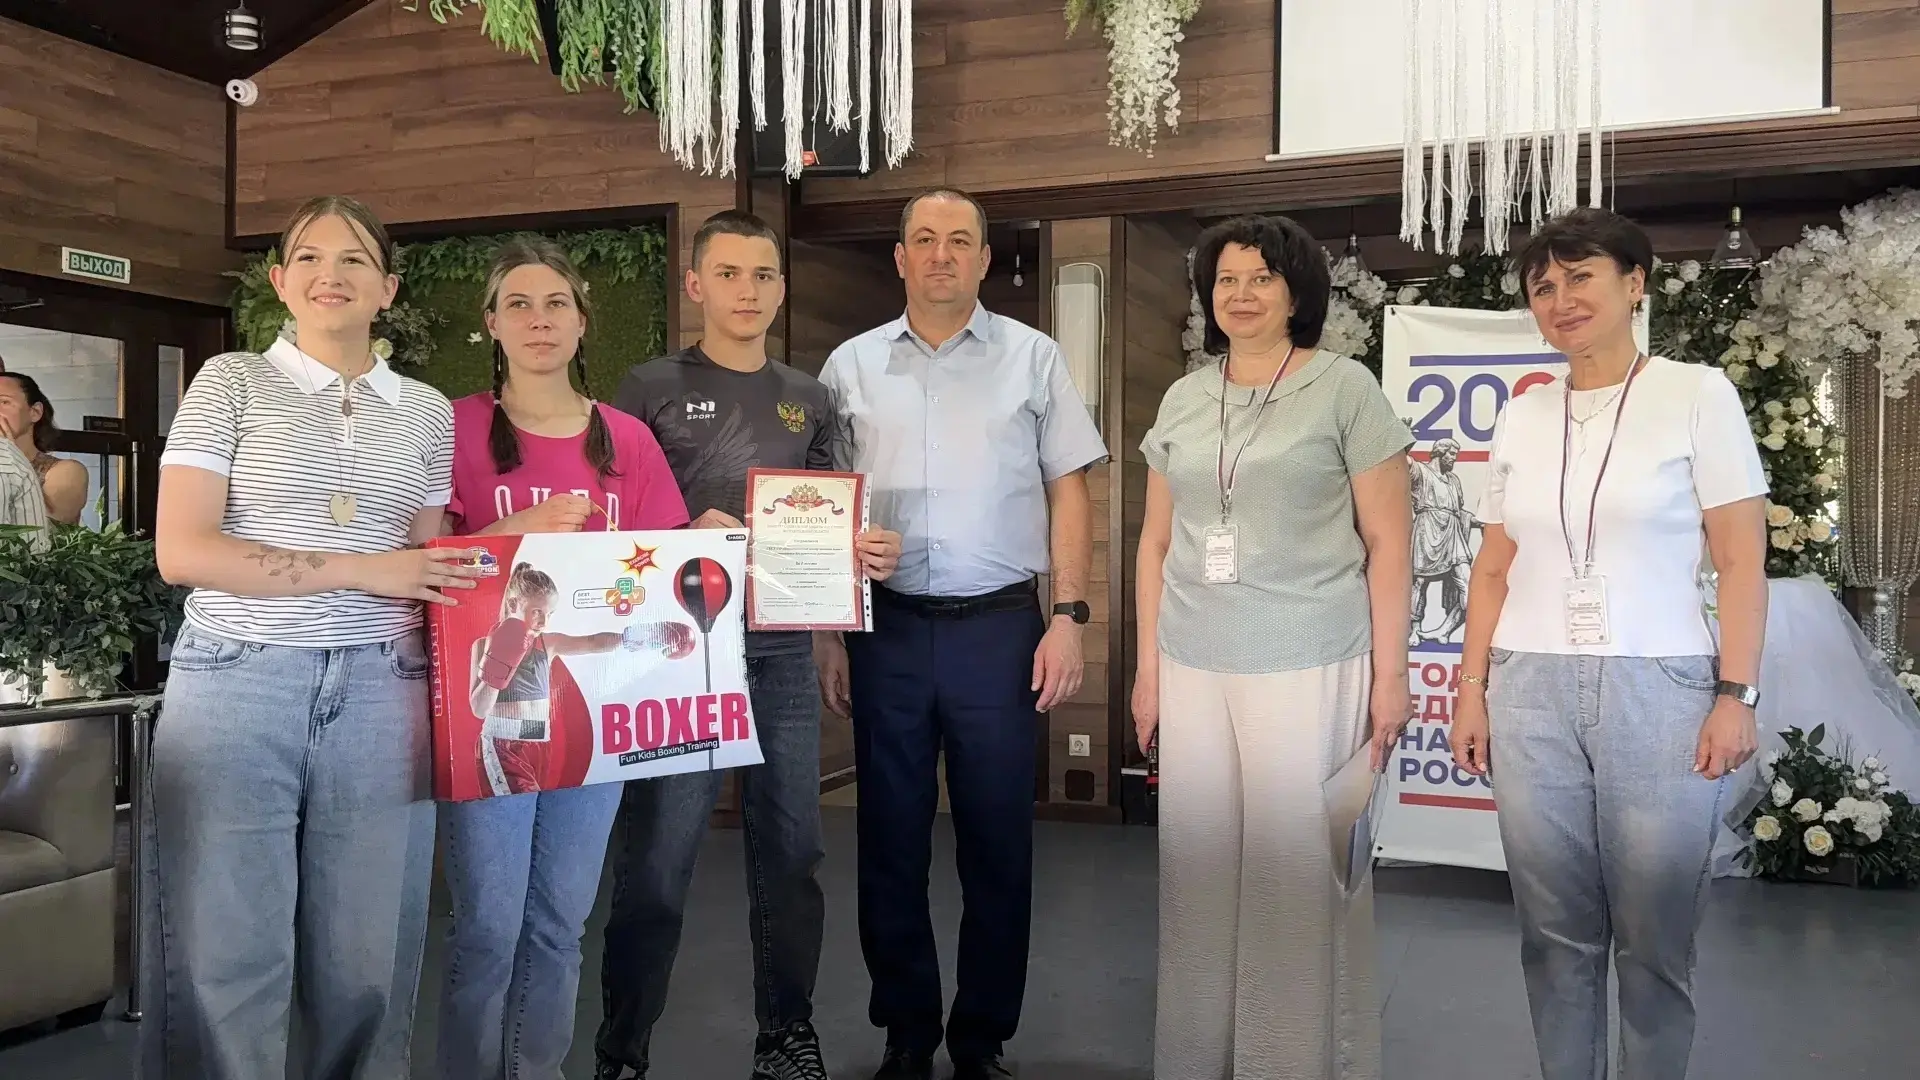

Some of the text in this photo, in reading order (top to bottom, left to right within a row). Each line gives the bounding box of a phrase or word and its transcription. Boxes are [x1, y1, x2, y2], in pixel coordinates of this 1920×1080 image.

[70, 254, 123, 278] ВЫХОД
[1407, 372, 1556, 442] 20
[780, 516, 828, 525] ДИПЛОМ
[601, 692, 749, 755] BOXER
[620, 739, 718, 764] Fun Kids Boxing Training
